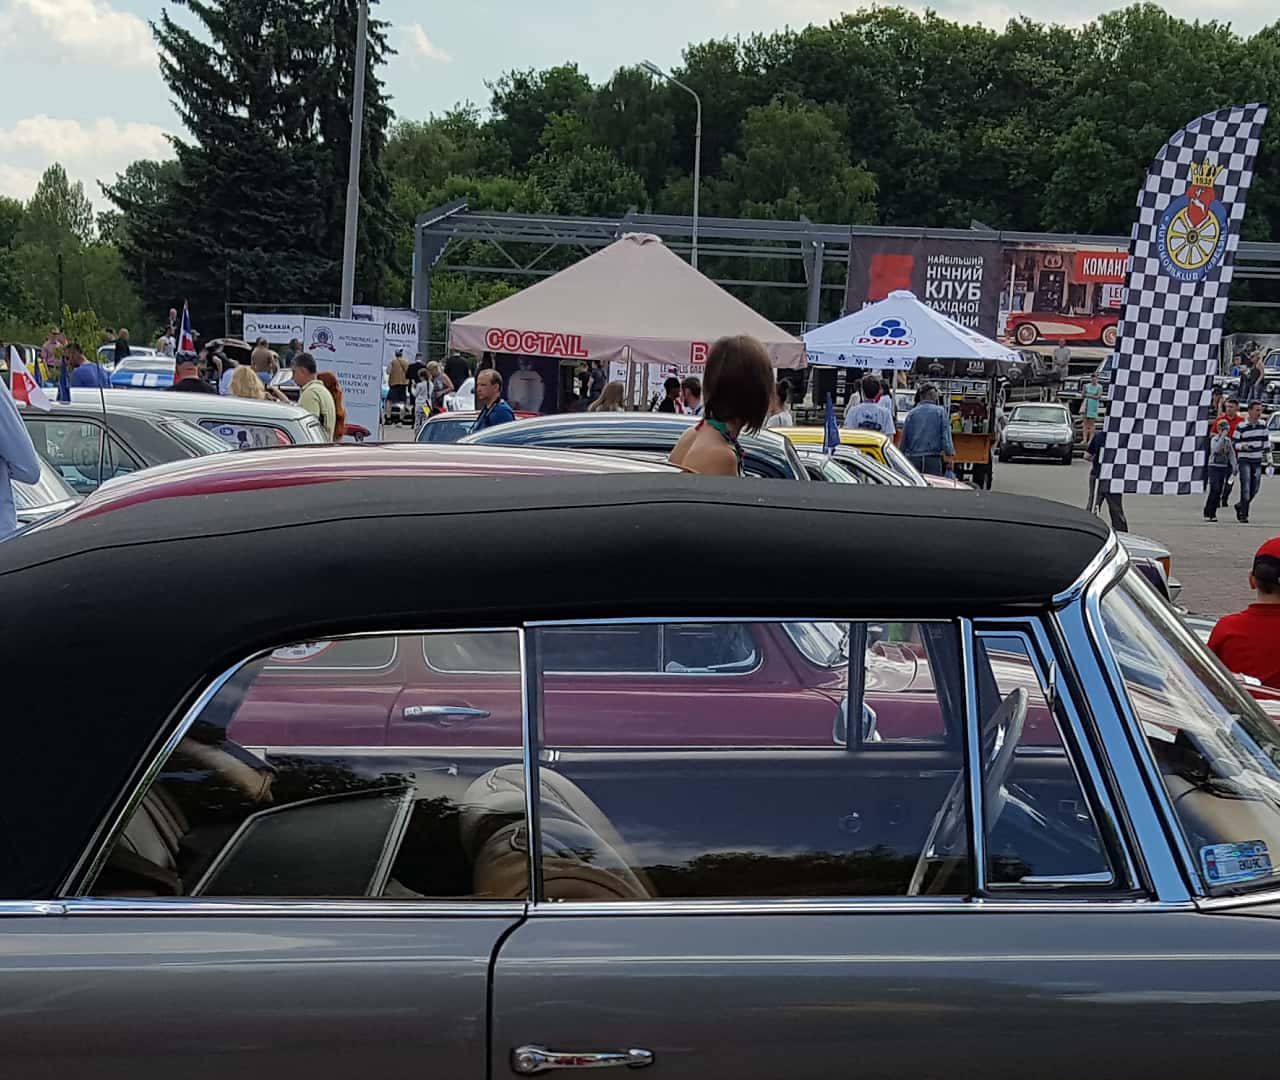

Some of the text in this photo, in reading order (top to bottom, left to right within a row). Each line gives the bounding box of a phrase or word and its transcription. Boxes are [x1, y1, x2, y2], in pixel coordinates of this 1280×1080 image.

[926, 265, 983, 281] НІЧНИЙ
[1083, 257, 1128, 279] КОМАНД
[925, 281, 981, 300] КЛУБ
[485, 328, 588, 357] COCTAIL
